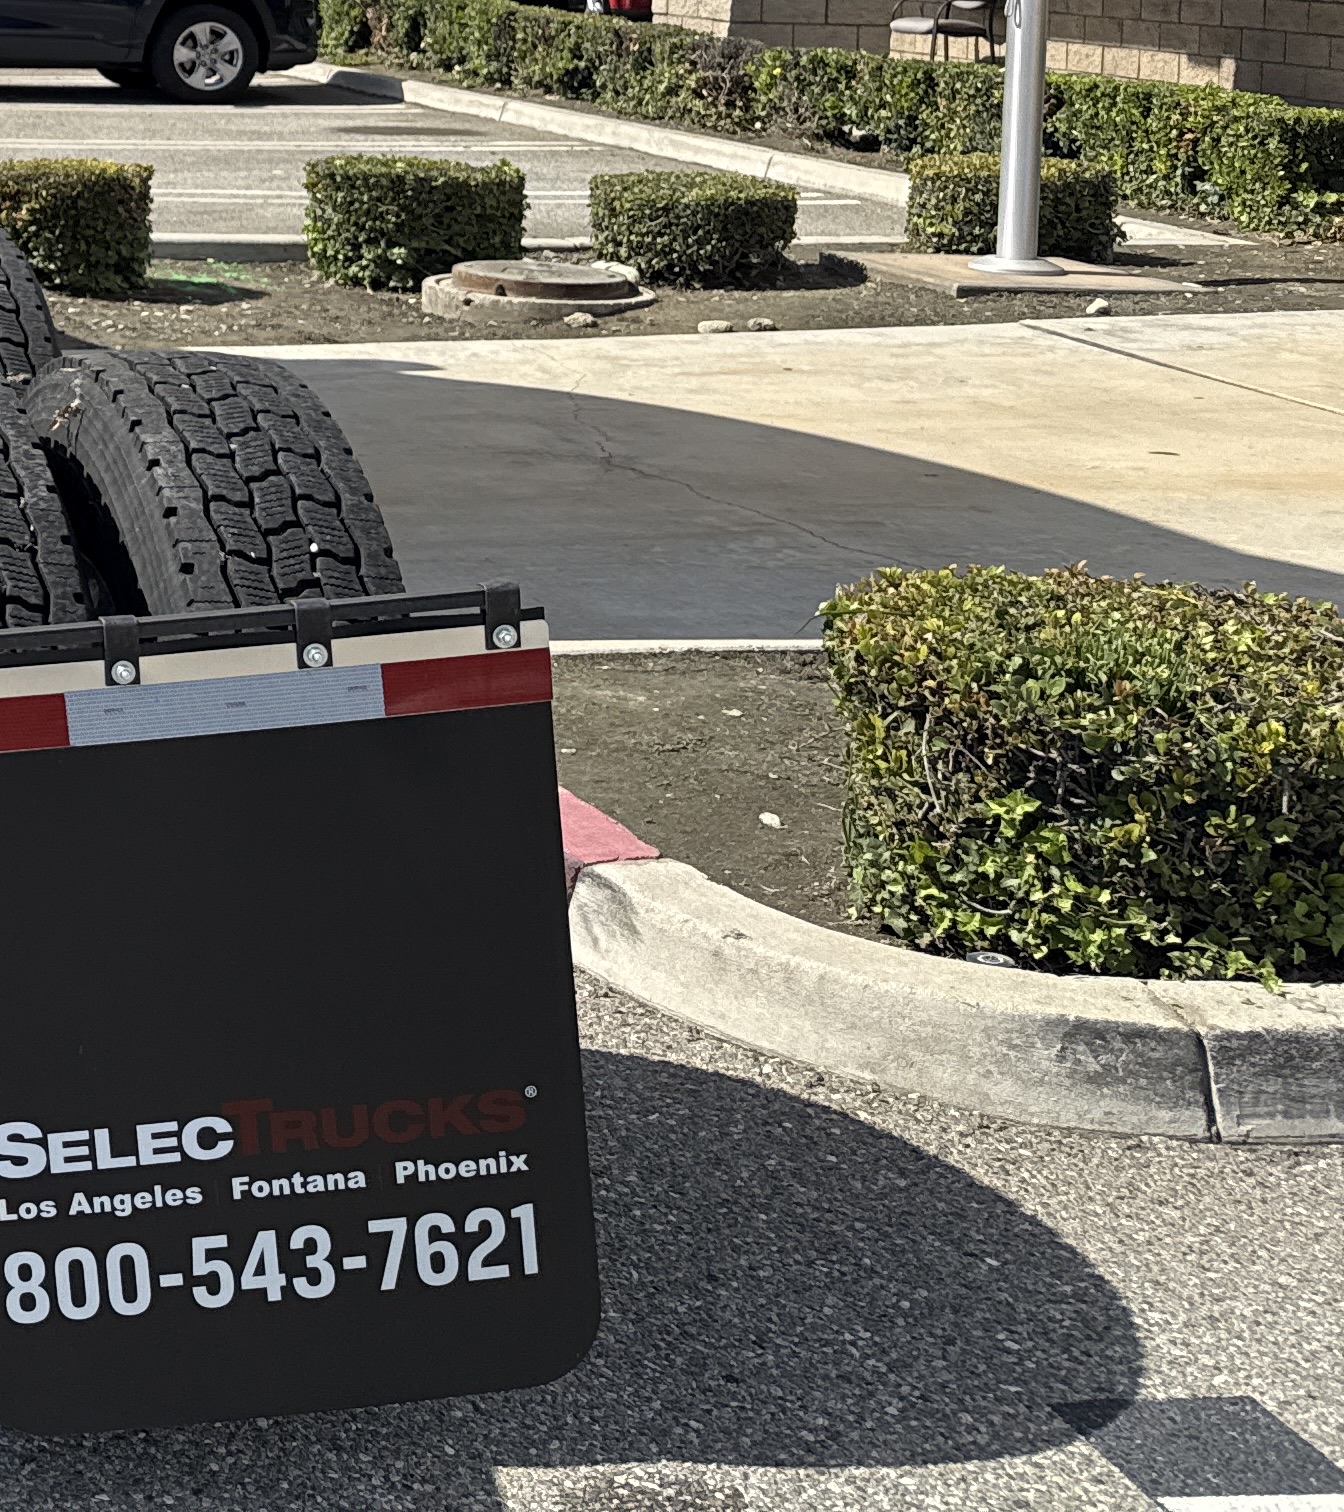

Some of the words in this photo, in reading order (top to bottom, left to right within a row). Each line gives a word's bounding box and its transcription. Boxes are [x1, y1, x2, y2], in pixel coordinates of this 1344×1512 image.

[68, 1184, 203, 1217] Angeles
[231, 1171, 367, 1200] Fontana
[394, 1150, 530, 1185] Phoenix
[3, 1202, 539, 1325] 800-543-7621
